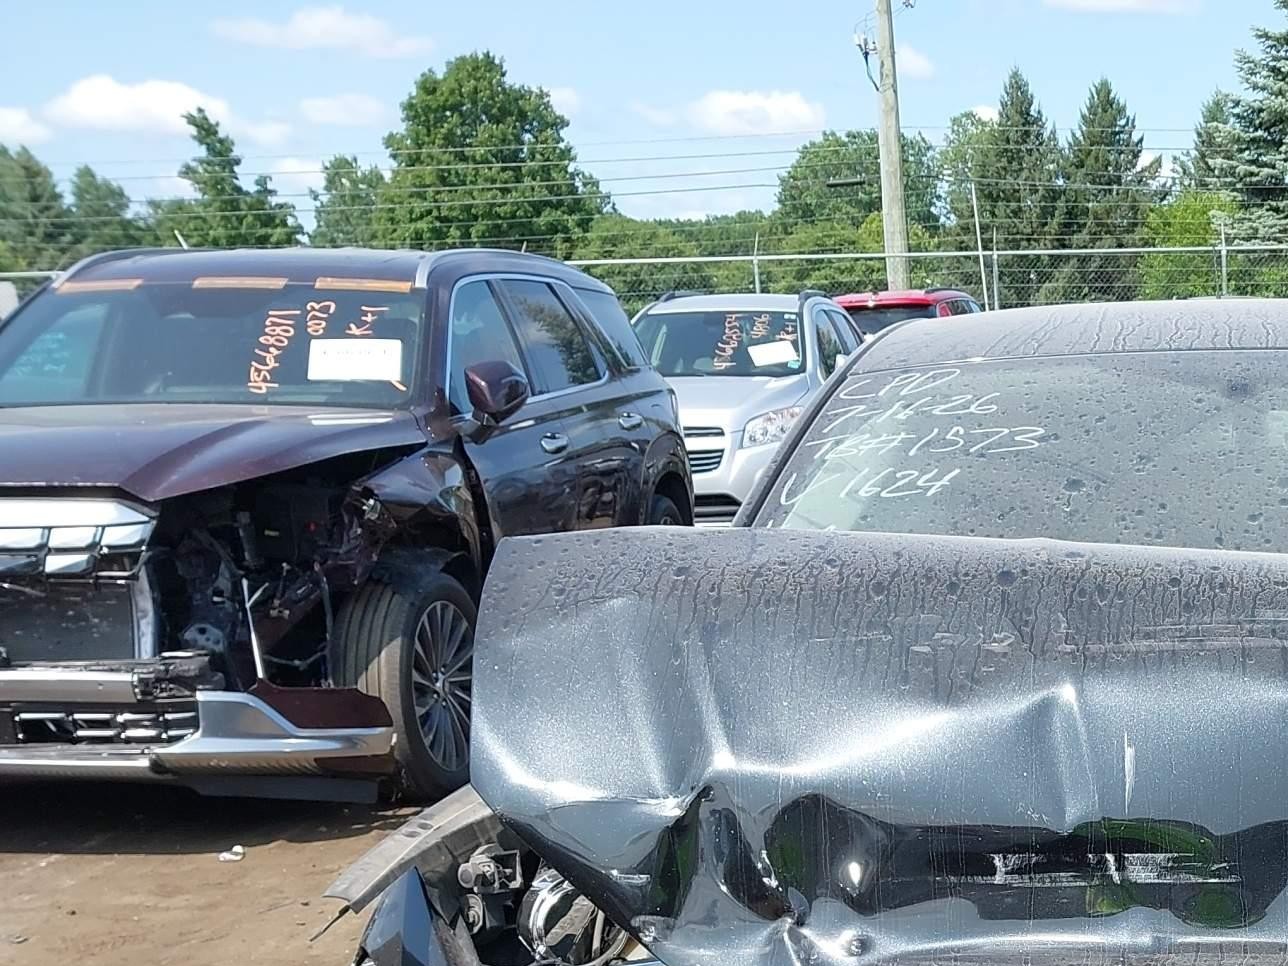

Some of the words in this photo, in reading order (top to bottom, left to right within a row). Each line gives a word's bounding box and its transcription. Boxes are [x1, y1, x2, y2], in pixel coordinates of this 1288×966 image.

[306, 301, 336, 336] 0073
[248, 310, 301, 393] 45668871
[839, 369, 961, 400] CPD
[821, 393, 1001, 433] 7-16-26
